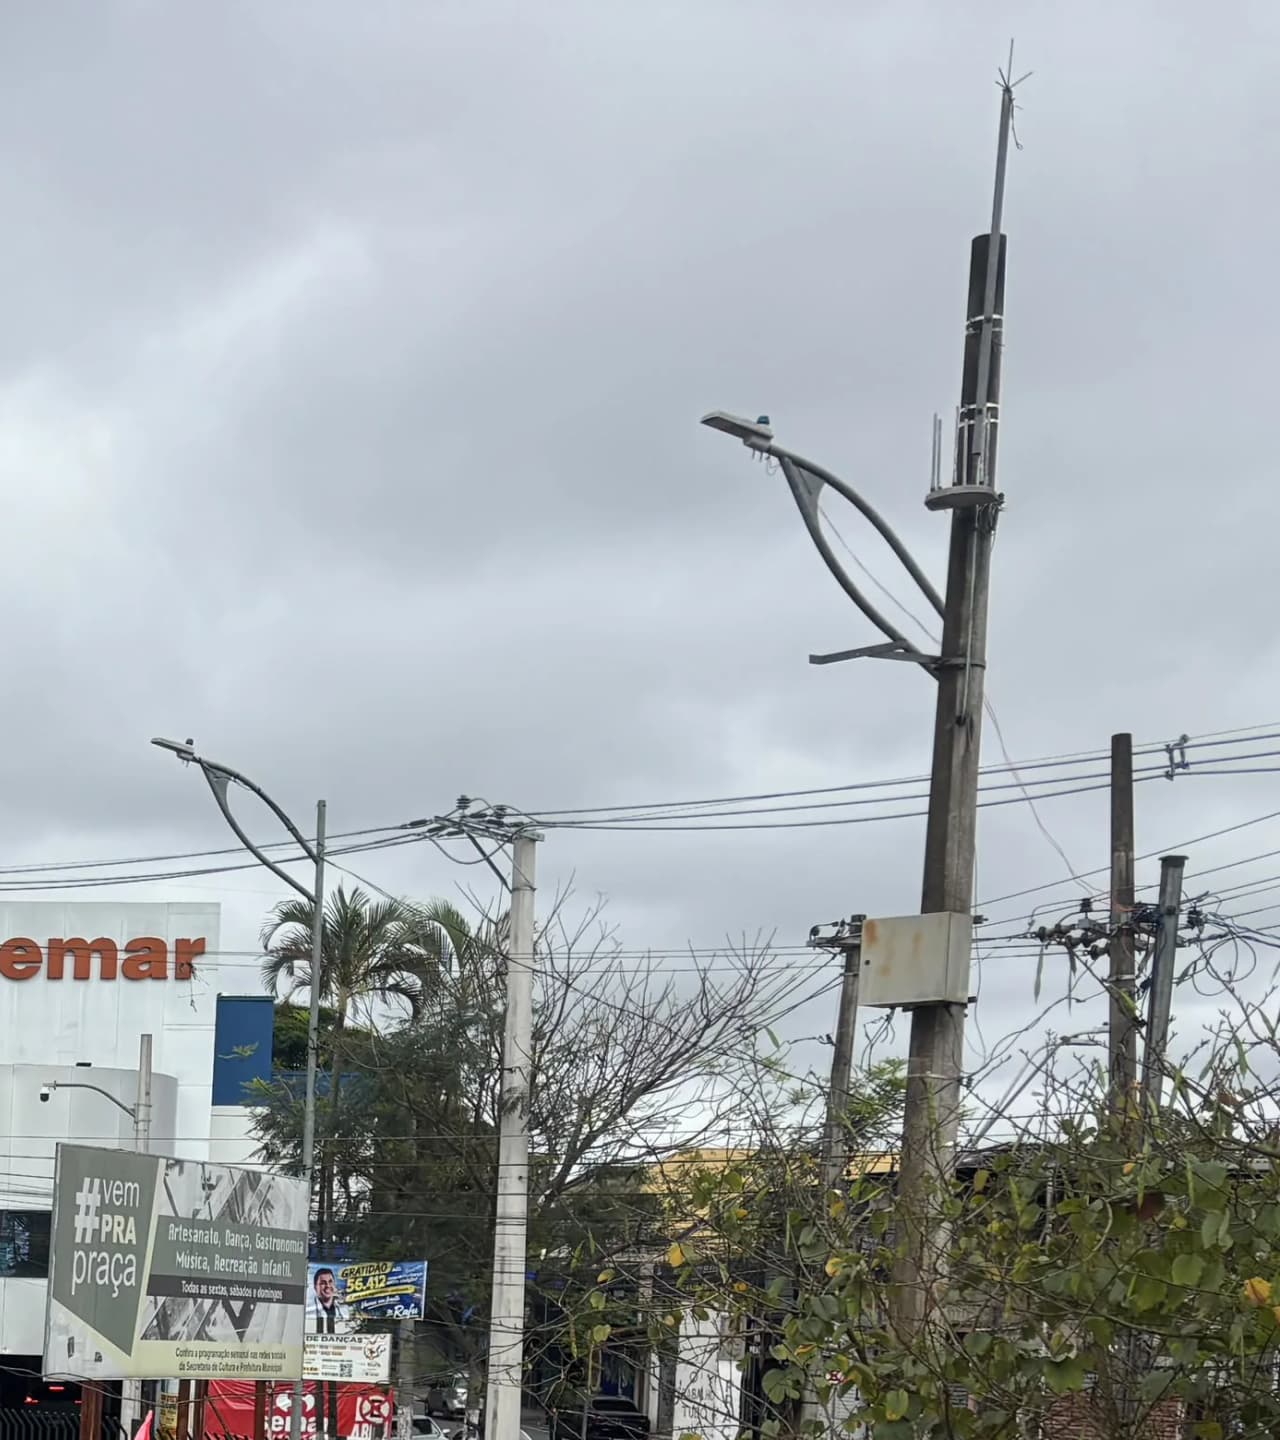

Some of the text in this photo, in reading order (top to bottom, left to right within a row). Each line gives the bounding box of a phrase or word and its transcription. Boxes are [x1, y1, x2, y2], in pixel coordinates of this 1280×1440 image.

[100, 1213, 137, 1245] PRA
[168, 1223, 304, 1254] Artesanato, Dança, Gastronomia
[71, 1249, 137, 1298] praça
[175, 1249, 210, 1273] Música,
[214, 1254, 258, 1279] Recreação
[346, 1275, 387, 1293] 56.412
